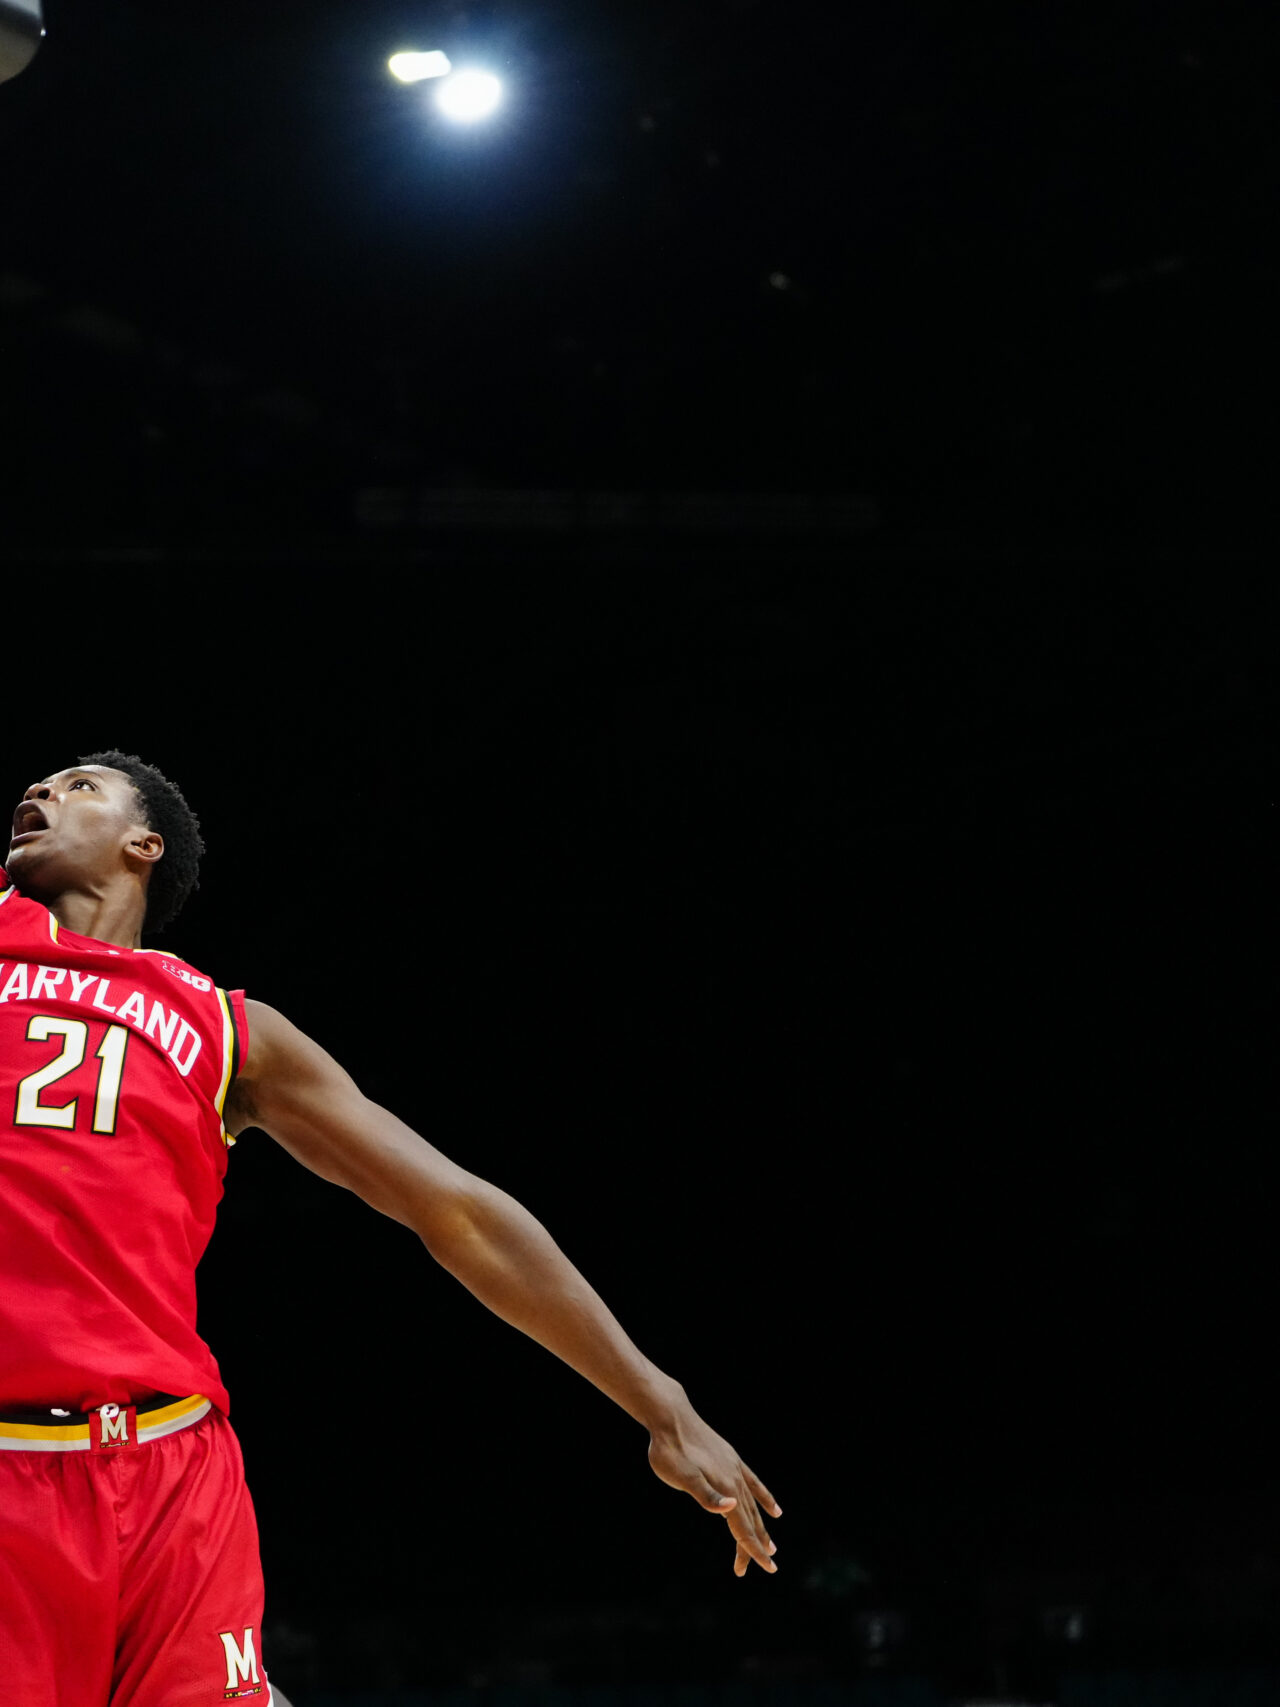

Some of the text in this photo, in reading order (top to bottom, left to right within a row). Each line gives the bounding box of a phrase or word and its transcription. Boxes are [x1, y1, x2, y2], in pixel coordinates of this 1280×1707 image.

[13, 1014, 131, 1136] 21
[99, 1409, 129, 1443] M
[218, 1626, 261, 1690] M
